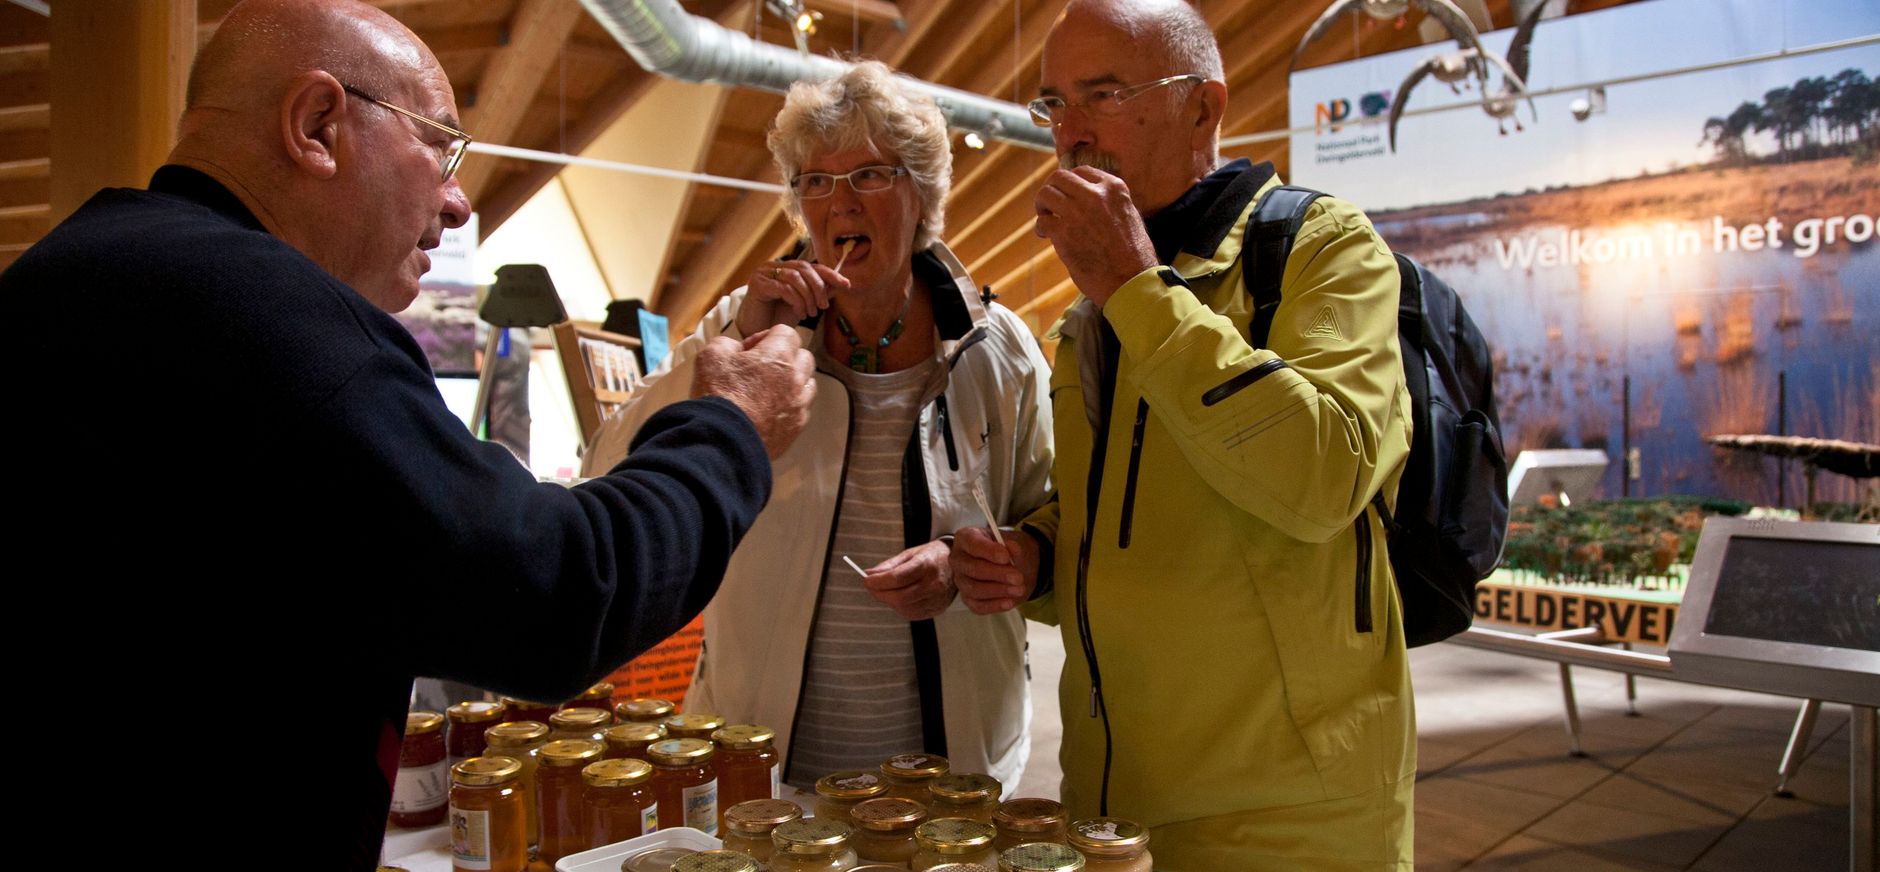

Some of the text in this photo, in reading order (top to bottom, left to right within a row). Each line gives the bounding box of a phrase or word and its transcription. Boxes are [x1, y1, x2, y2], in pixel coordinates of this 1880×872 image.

[1495, 213, 1880, 270] Welkom in het gro
